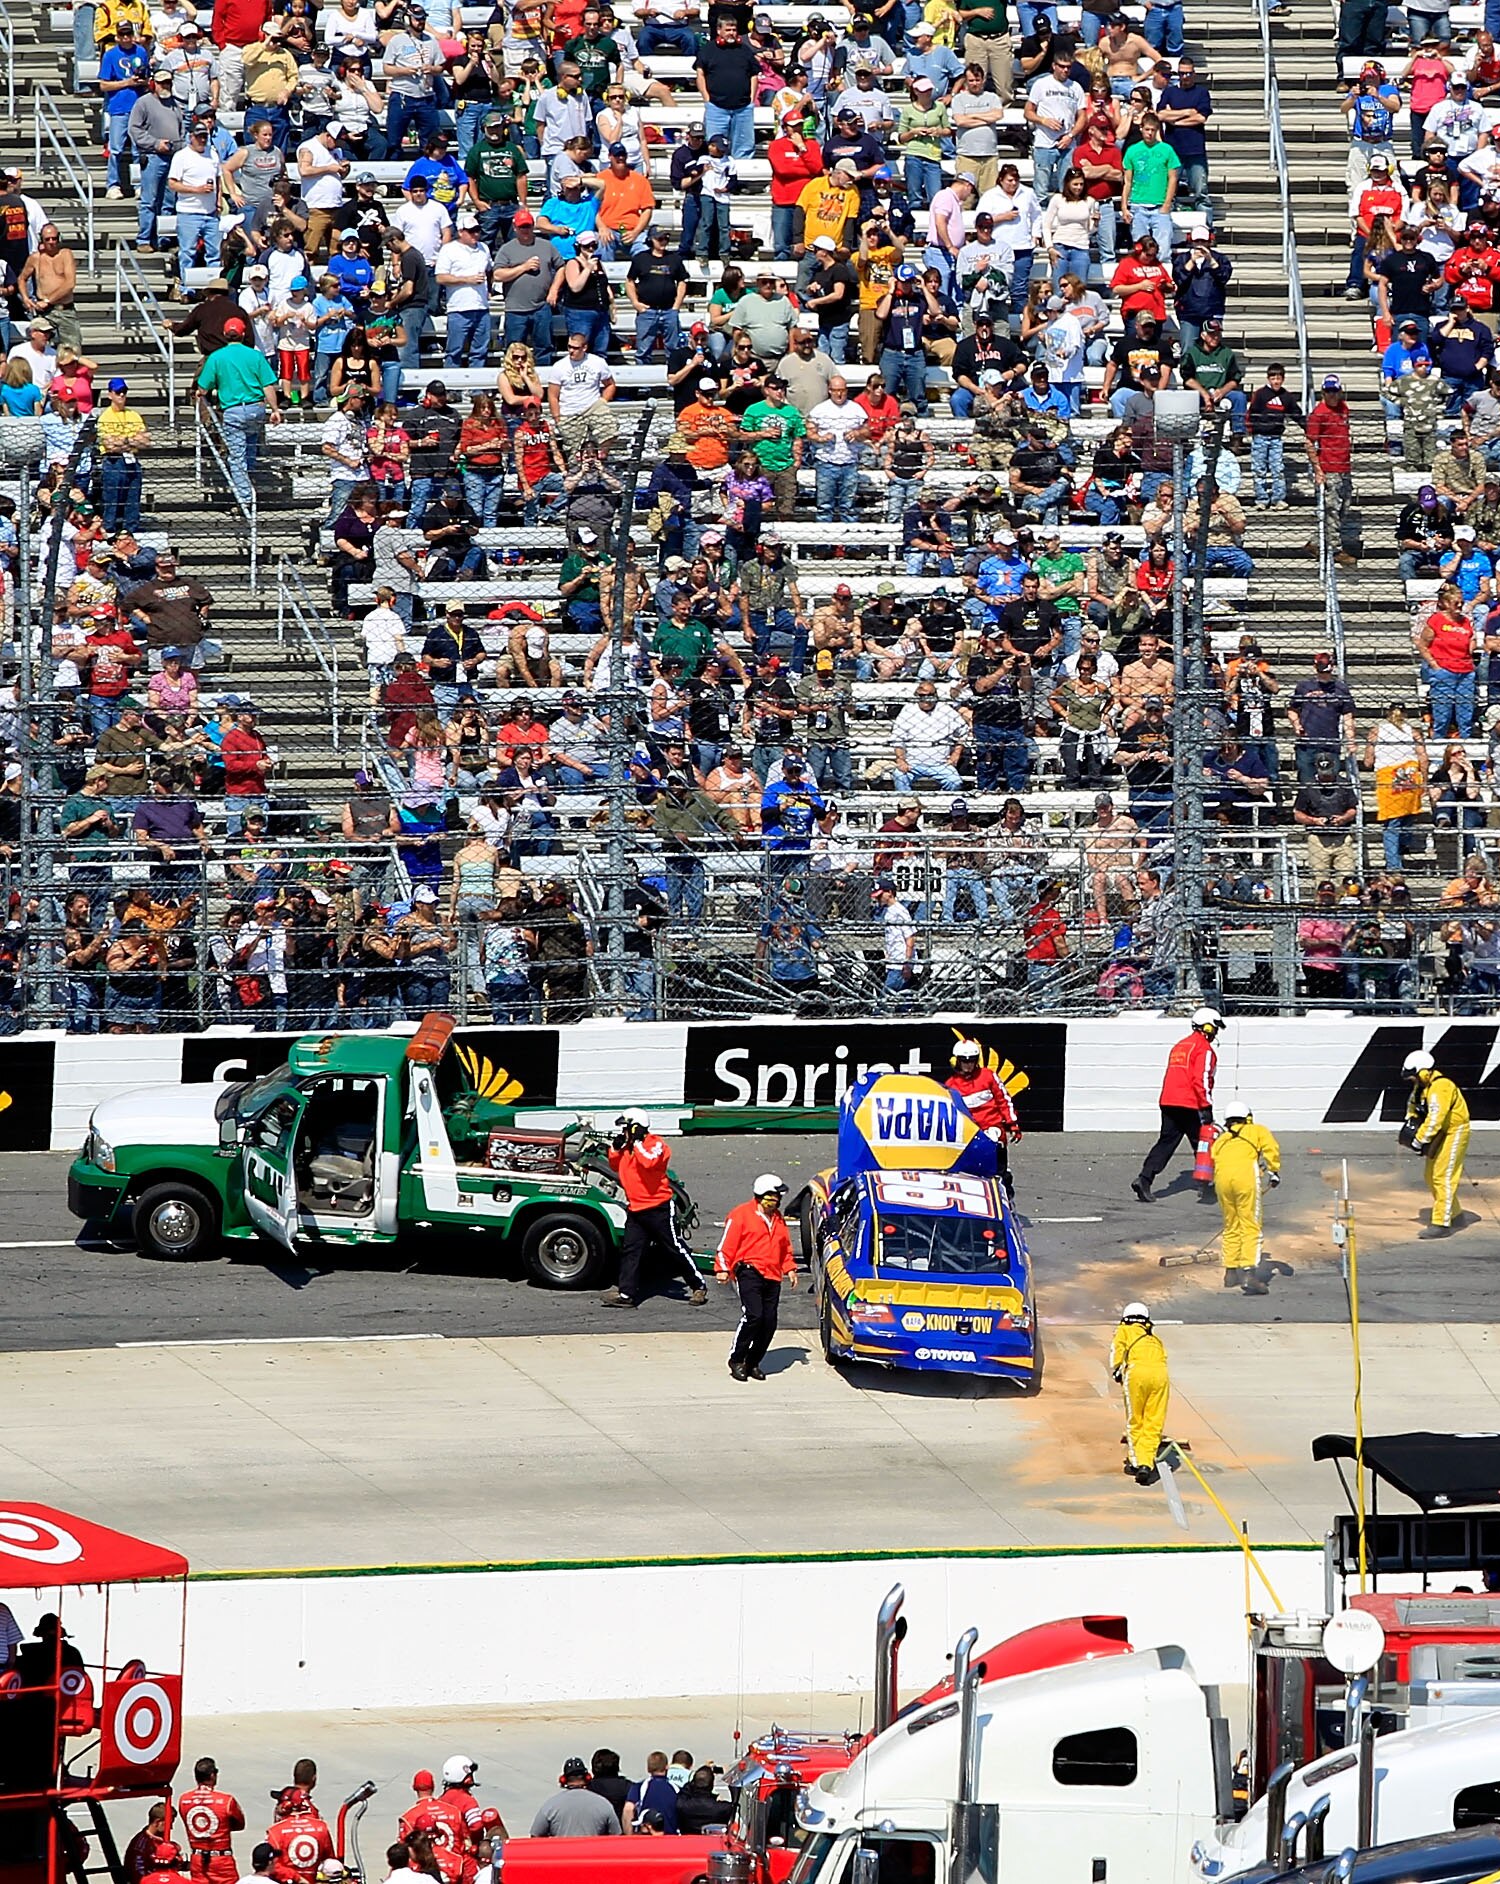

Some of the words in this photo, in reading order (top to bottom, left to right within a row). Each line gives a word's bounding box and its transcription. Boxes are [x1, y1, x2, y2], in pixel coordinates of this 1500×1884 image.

[574, 372, 587, 383] 87
[876, 1097, 957, 1142] NAPA
[930, 1348, 977, 1363] TOYOTA
